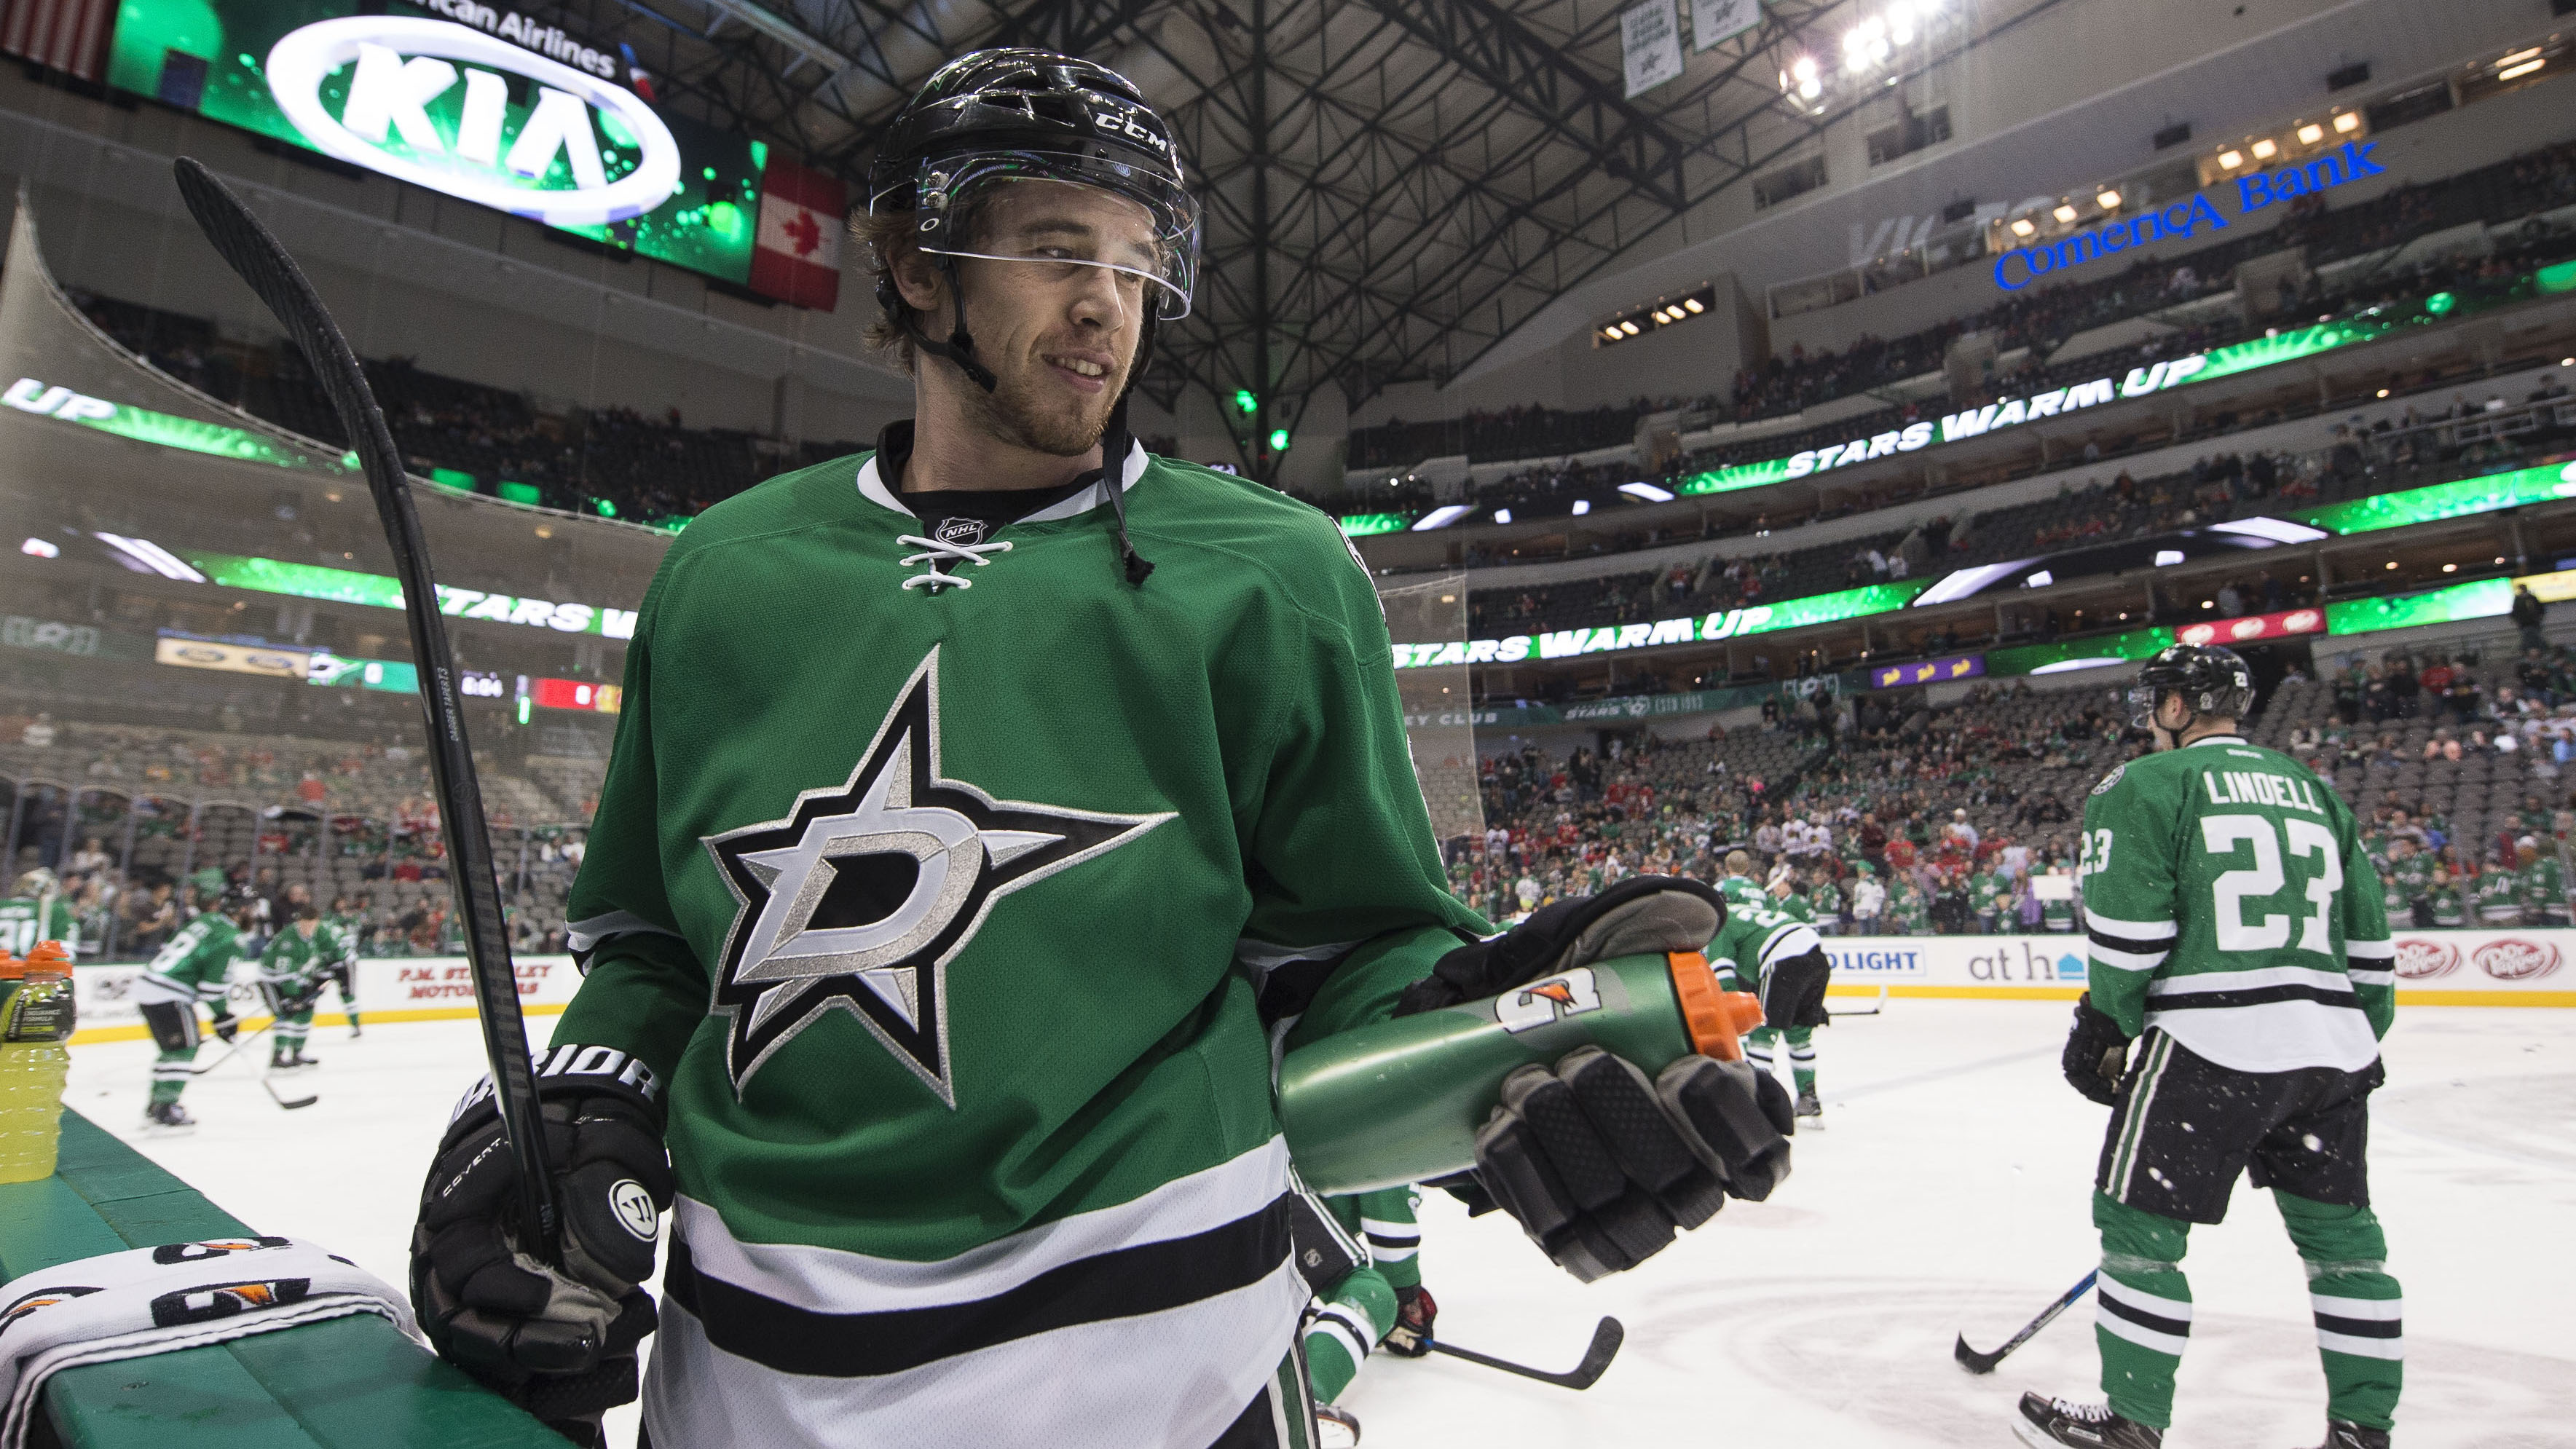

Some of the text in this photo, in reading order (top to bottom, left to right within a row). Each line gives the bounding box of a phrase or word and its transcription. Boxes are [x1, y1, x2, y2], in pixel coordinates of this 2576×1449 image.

[498, 12, 616, 78] Airlines
[342, 42, 609, 191] KIA
[1095, 112, 1167, 151] CCM
[2234, 142, 2386, 213] Bank
[3, 377, 117, 421] UP
[1785, 355, 2207, 480] STARS WARM UP
[945, 524, 977, 537] NHL
[1392, 606, 1773, 670] STARS WARM UP
[2203, 770, 2325, 816] LINDELL
[2079, 827, 2114, 874] 23
[2199, 814, 2344, 955] 23
[1843, 952, 1918, 970] LIGHT
[1969, 948, 2011, 981] at
